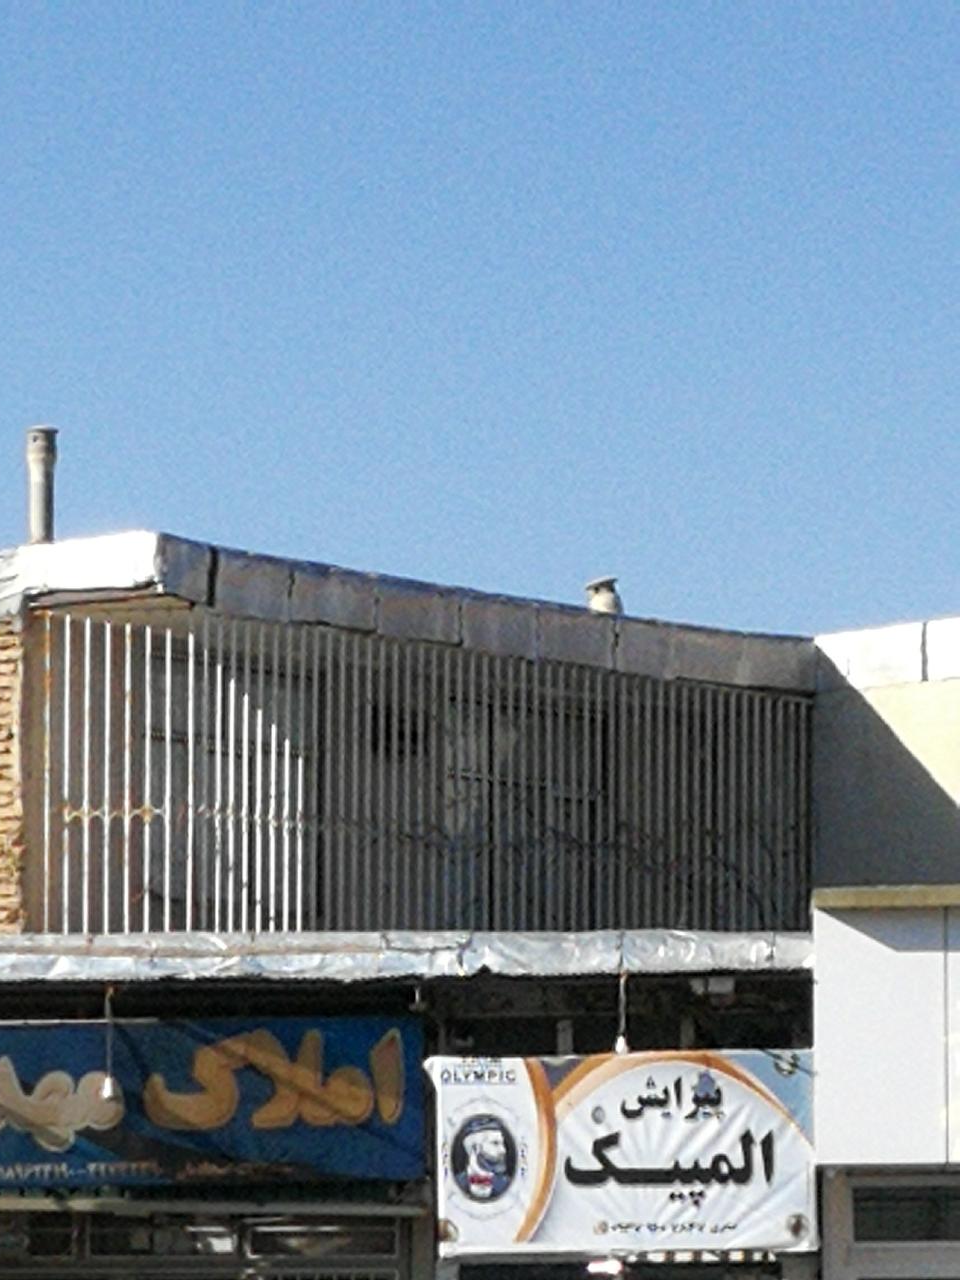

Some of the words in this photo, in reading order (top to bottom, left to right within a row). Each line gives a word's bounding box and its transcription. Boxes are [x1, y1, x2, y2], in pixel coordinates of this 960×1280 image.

[143, 1027, 405, 1130] املاک
[440, 1068, 517, 1083] OLYMPIC
[564, 1128, 774, 1209] المپیک
